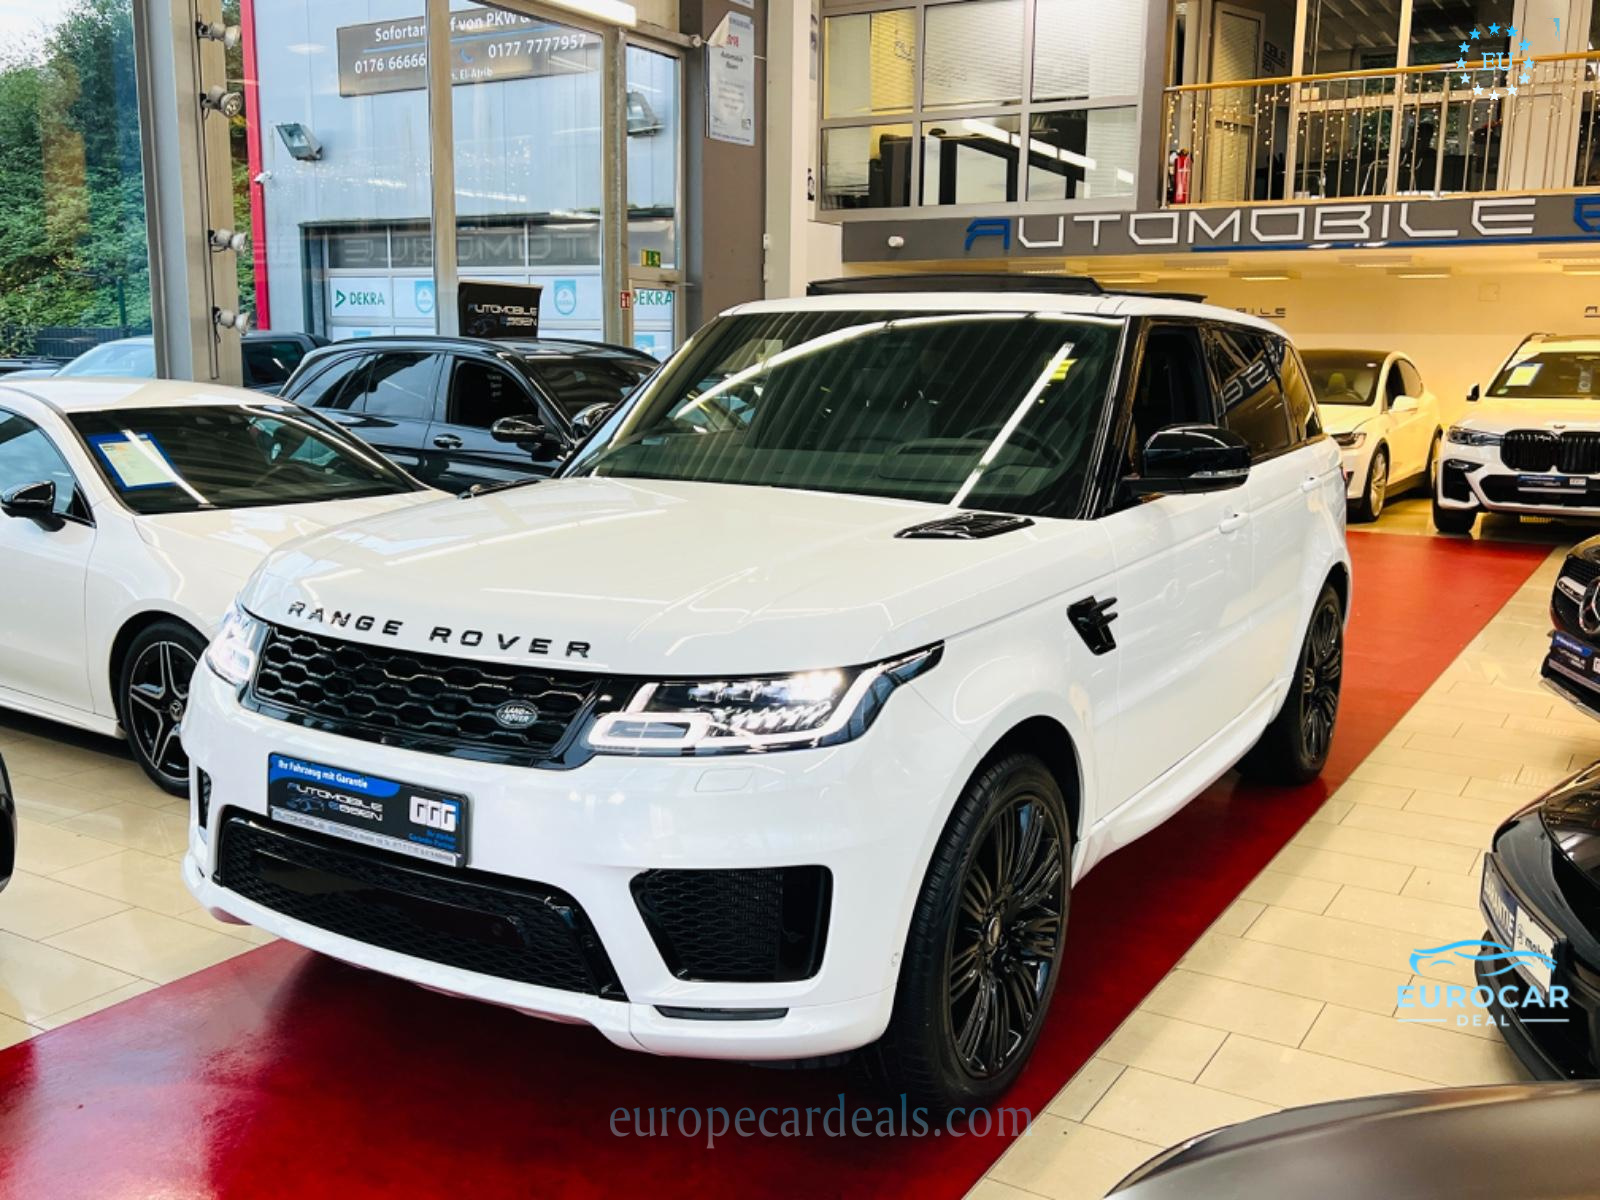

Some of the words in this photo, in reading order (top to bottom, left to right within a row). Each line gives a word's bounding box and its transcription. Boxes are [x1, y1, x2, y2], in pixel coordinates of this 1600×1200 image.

[459, 17, 483, 31] von
[486, 10, 517, 26] PKW
[488, 41, 521, 59] 0177
[527, 34, 586, 54] 7777957
[355, 58, 384, 74] 0176
[964, 198, 1536, 252] AUTOMOBILE
[350, 292, 385, 306] DEKRA
[467, 304, 538, 317] AUTOMOBILE
[288, 601, 403, 636] RANGE
[429, 627, 592, 658] ROVER
[504, 704, 526, 714] LAND
[278, 759, 288, 769] Ihr
[289, 762, 321, 780] Fahrzeug
[322, 770, 335, 781] mit
[336, 773, 368, 788] Garantie
[287, 782, 384, 812] AUTOMOBILE
